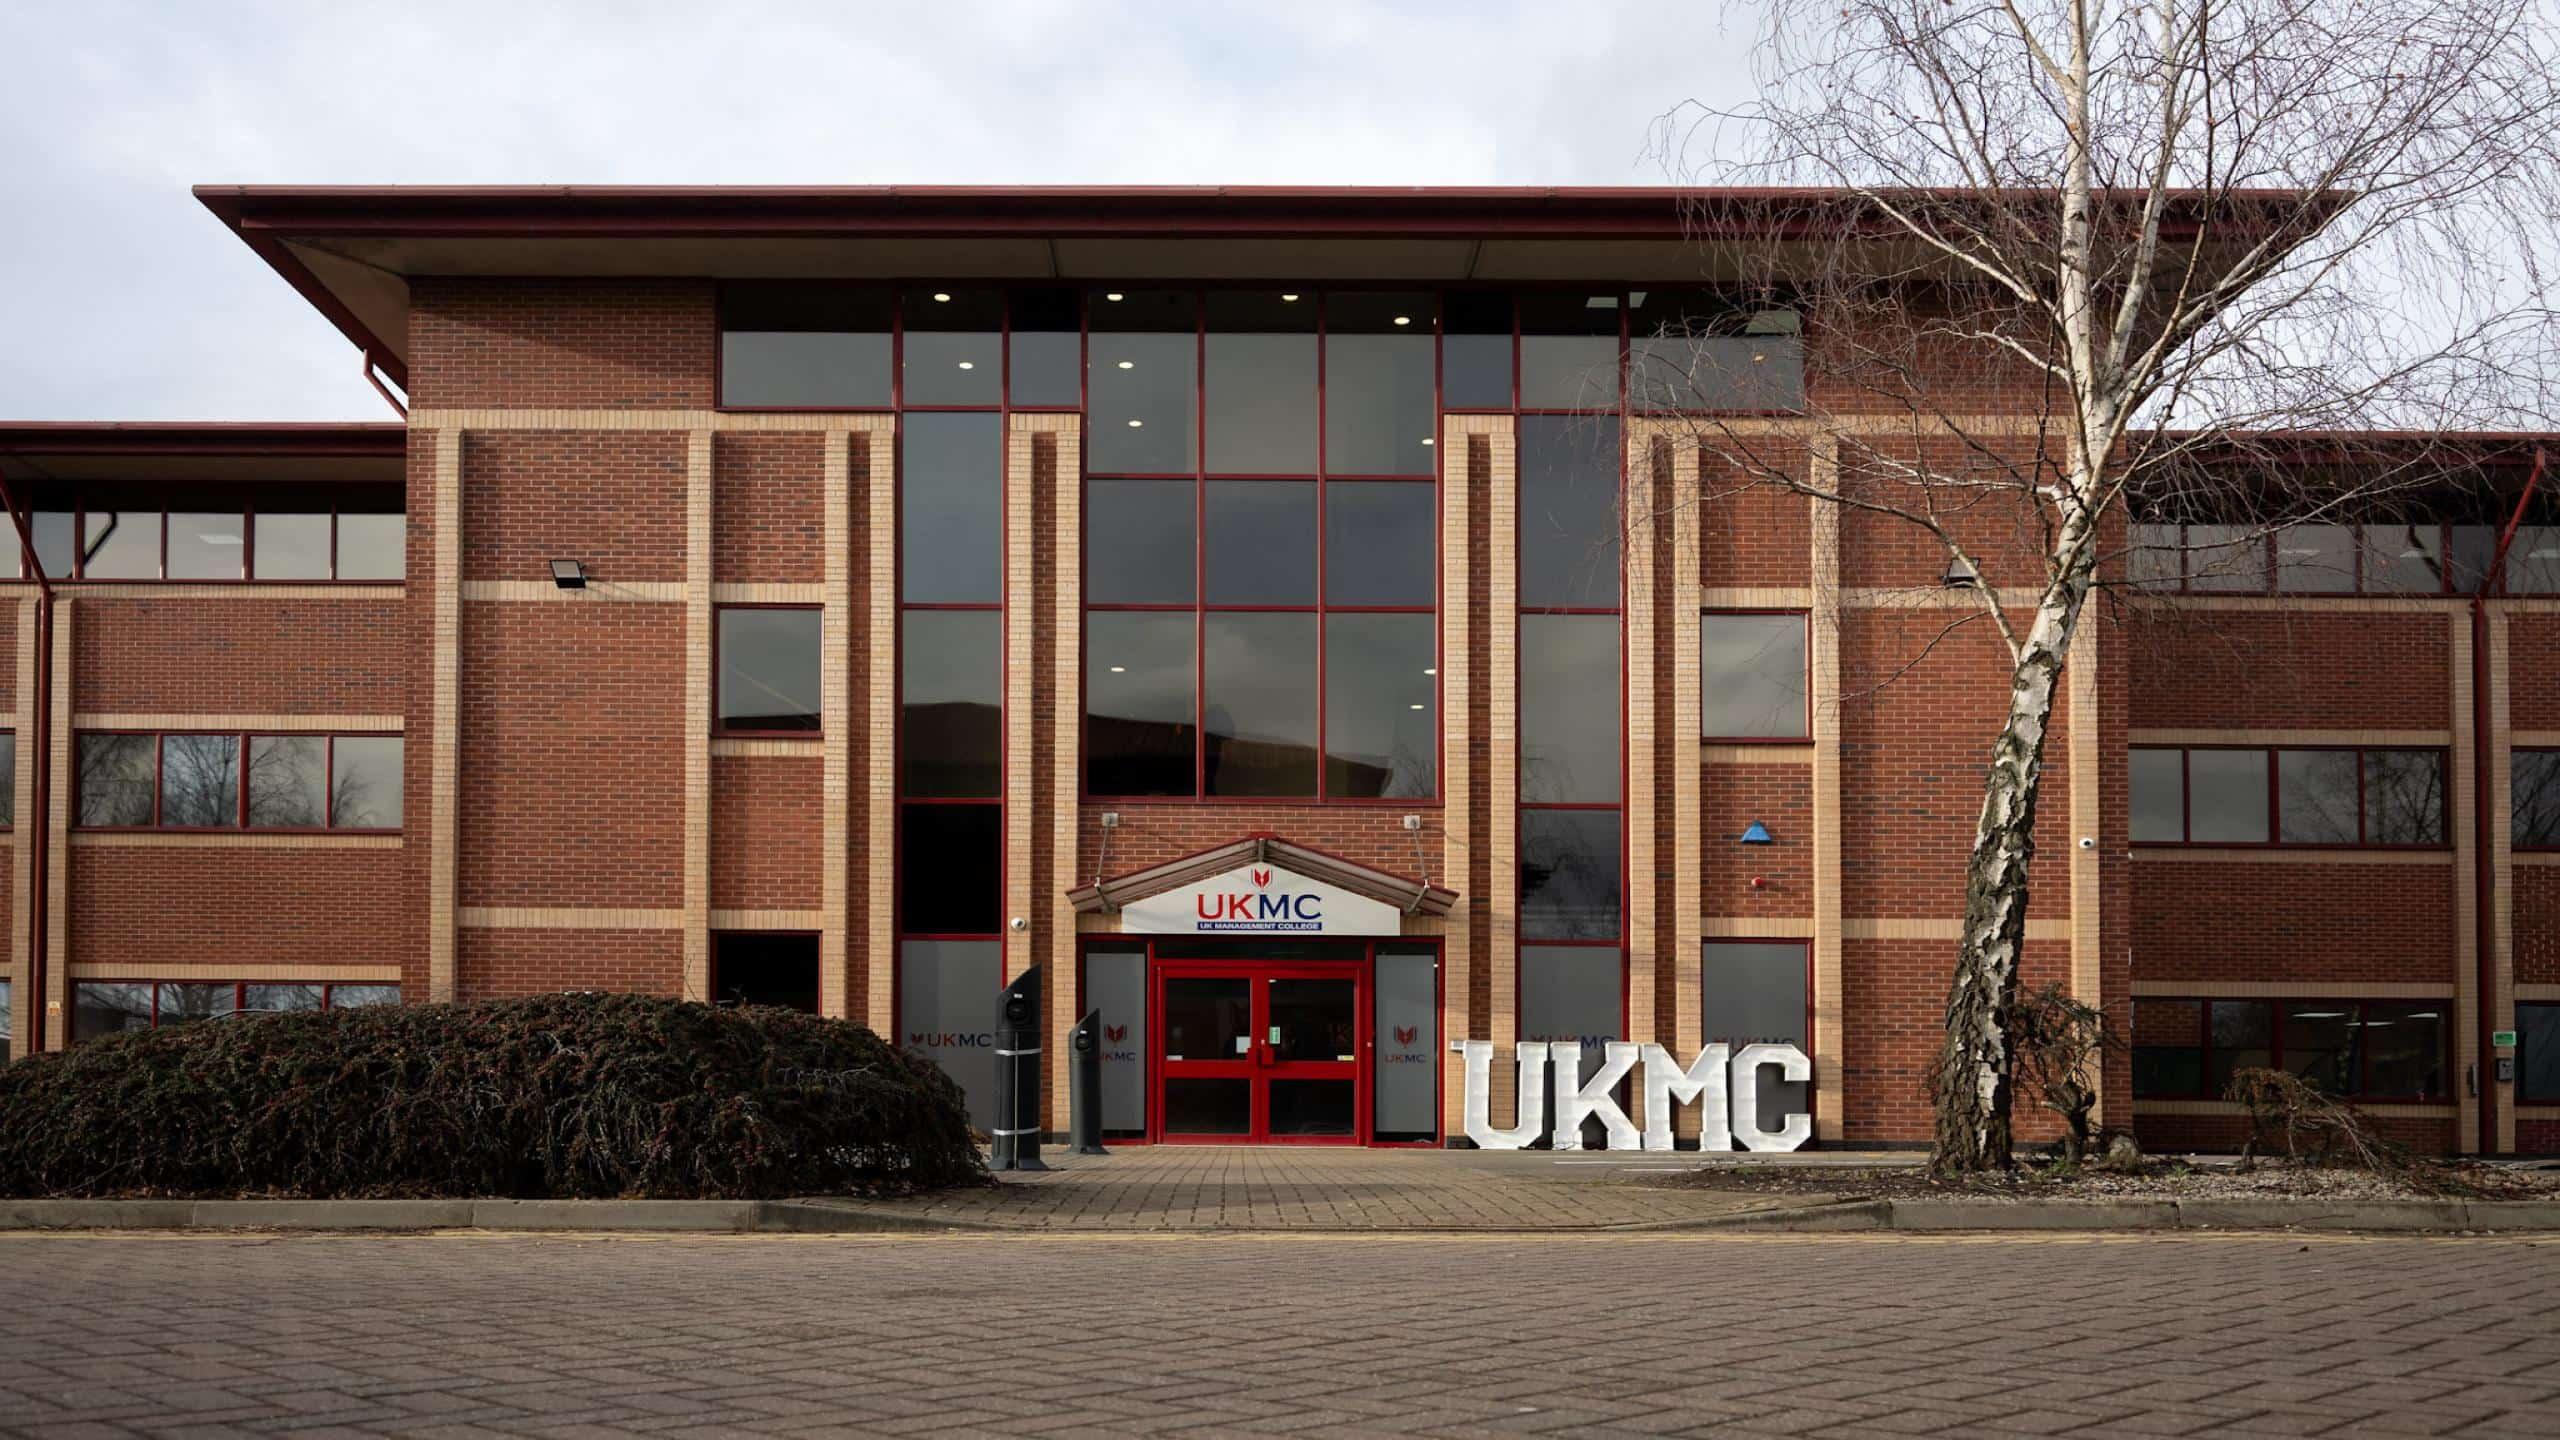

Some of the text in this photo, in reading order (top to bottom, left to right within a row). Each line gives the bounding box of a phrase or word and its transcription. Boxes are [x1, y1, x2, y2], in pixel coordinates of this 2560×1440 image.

[1197, 894, 1322, 919] UKMC
[927, 1033, 992, 1048] UKMC
[1384, 1054, 1426, 1064] UKMC
[1452, 1040, 1811, 1152] UKMC
